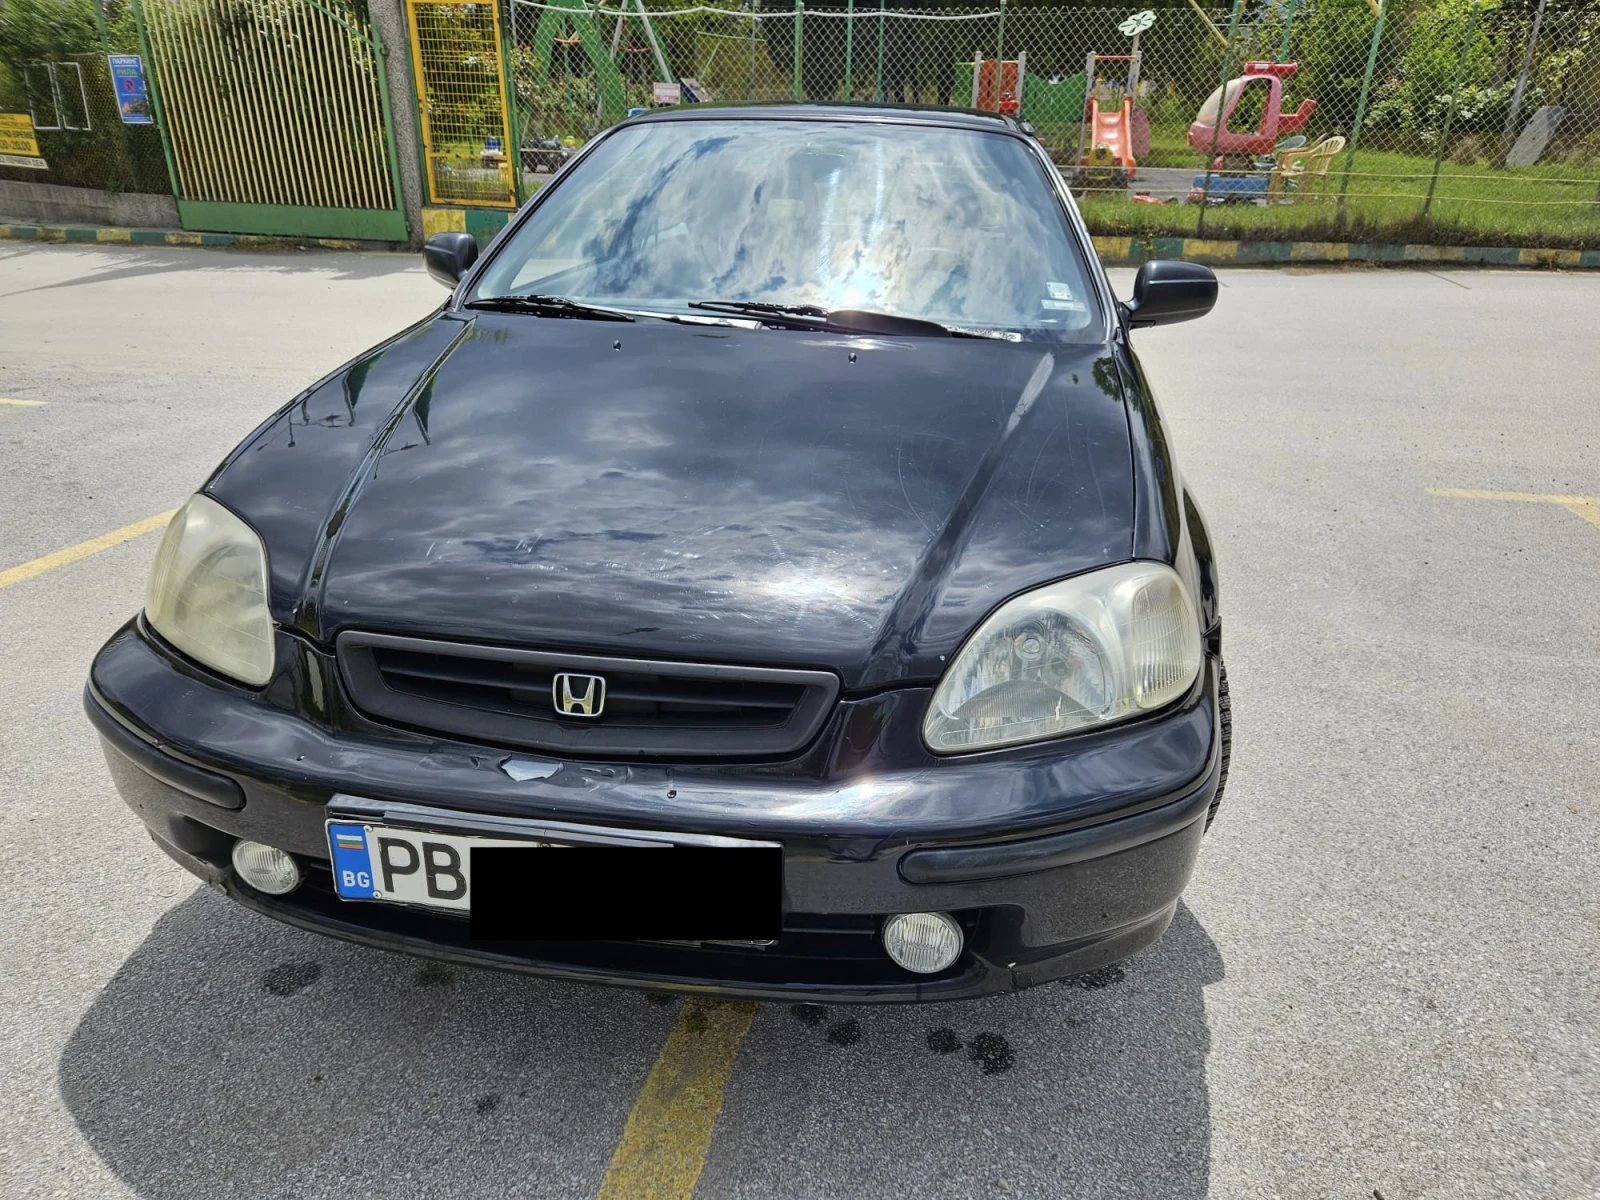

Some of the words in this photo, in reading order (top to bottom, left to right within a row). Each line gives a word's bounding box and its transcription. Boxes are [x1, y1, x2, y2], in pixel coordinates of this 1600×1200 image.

[112, 57, 137, 65] ПАРКИНГ
[378, 837, 467, 900] PB
[342, 870, 370, 888] BG
